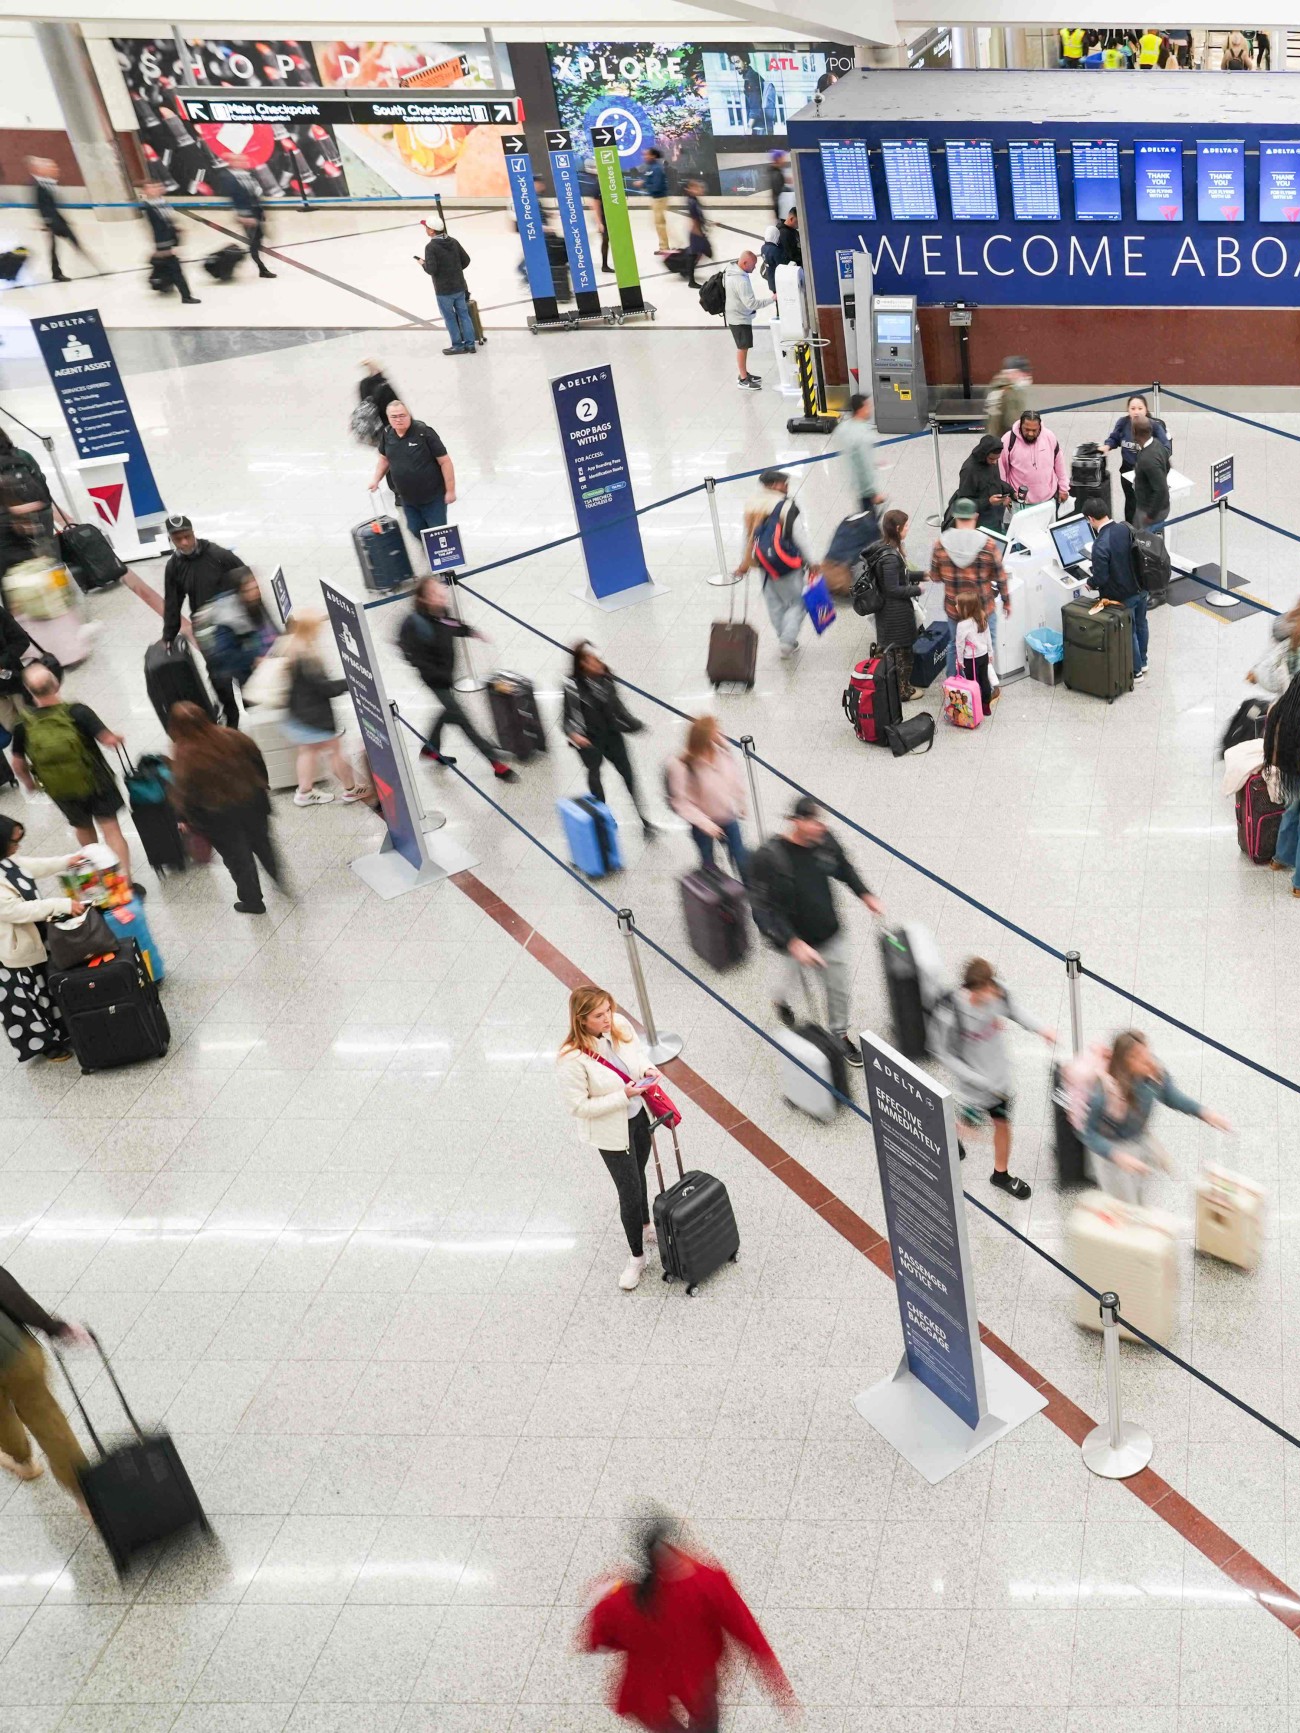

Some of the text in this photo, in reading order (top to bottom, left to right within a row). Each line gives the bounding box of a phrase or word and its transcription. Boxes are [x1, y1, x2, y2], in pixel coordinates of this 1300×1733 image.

[338, 55, 495, 80] DIE
[554, 56, 684, 80] XPLORE
[768, 58, 799, 72] ATL
[227, 102, 321, 117] Main Checkpoint
[372, 104, 471, 117] South Checkpoint
[562, 170, 570, 180] ID
[608, 166, 617, 192] Gates
[565, 182, 577, 224] Touchless
[528, 222, 536, 240] TSA
[858, 234, 1146, 276] WELCOME
[580, 270, 588, 288] TSA
[50, 318, 86, 329] DELTA
[54, 360, 112, 377] AGENT ASSIST
[568, 374, 598, 388] DELTA
[582, 402, 592, 418] 2
[570, 422, 612, 440] DROP BAGS
[577, 432, 608, 446] WITH ID
[574, 452, 604, 464] FOR ACCESS:
[588, 469, 612, 479] Identification
[331, 594, 350, 613] DELTA
[341, 650, 350, 664] APP
[884, 1065, 924, 1102] DELTA
[876, 1086, 922, 1130] EFFECTIVE
[878, 1098, 940, 1156] IMMEDIATELY
[898, 1246, 948, 1295] PASSENGER
[900, 1257, 933, 1291] NOTICE
[906, 1300, 947, 1340] CHECKED
[908, 1310, 950, 1354] BAGGAGE
